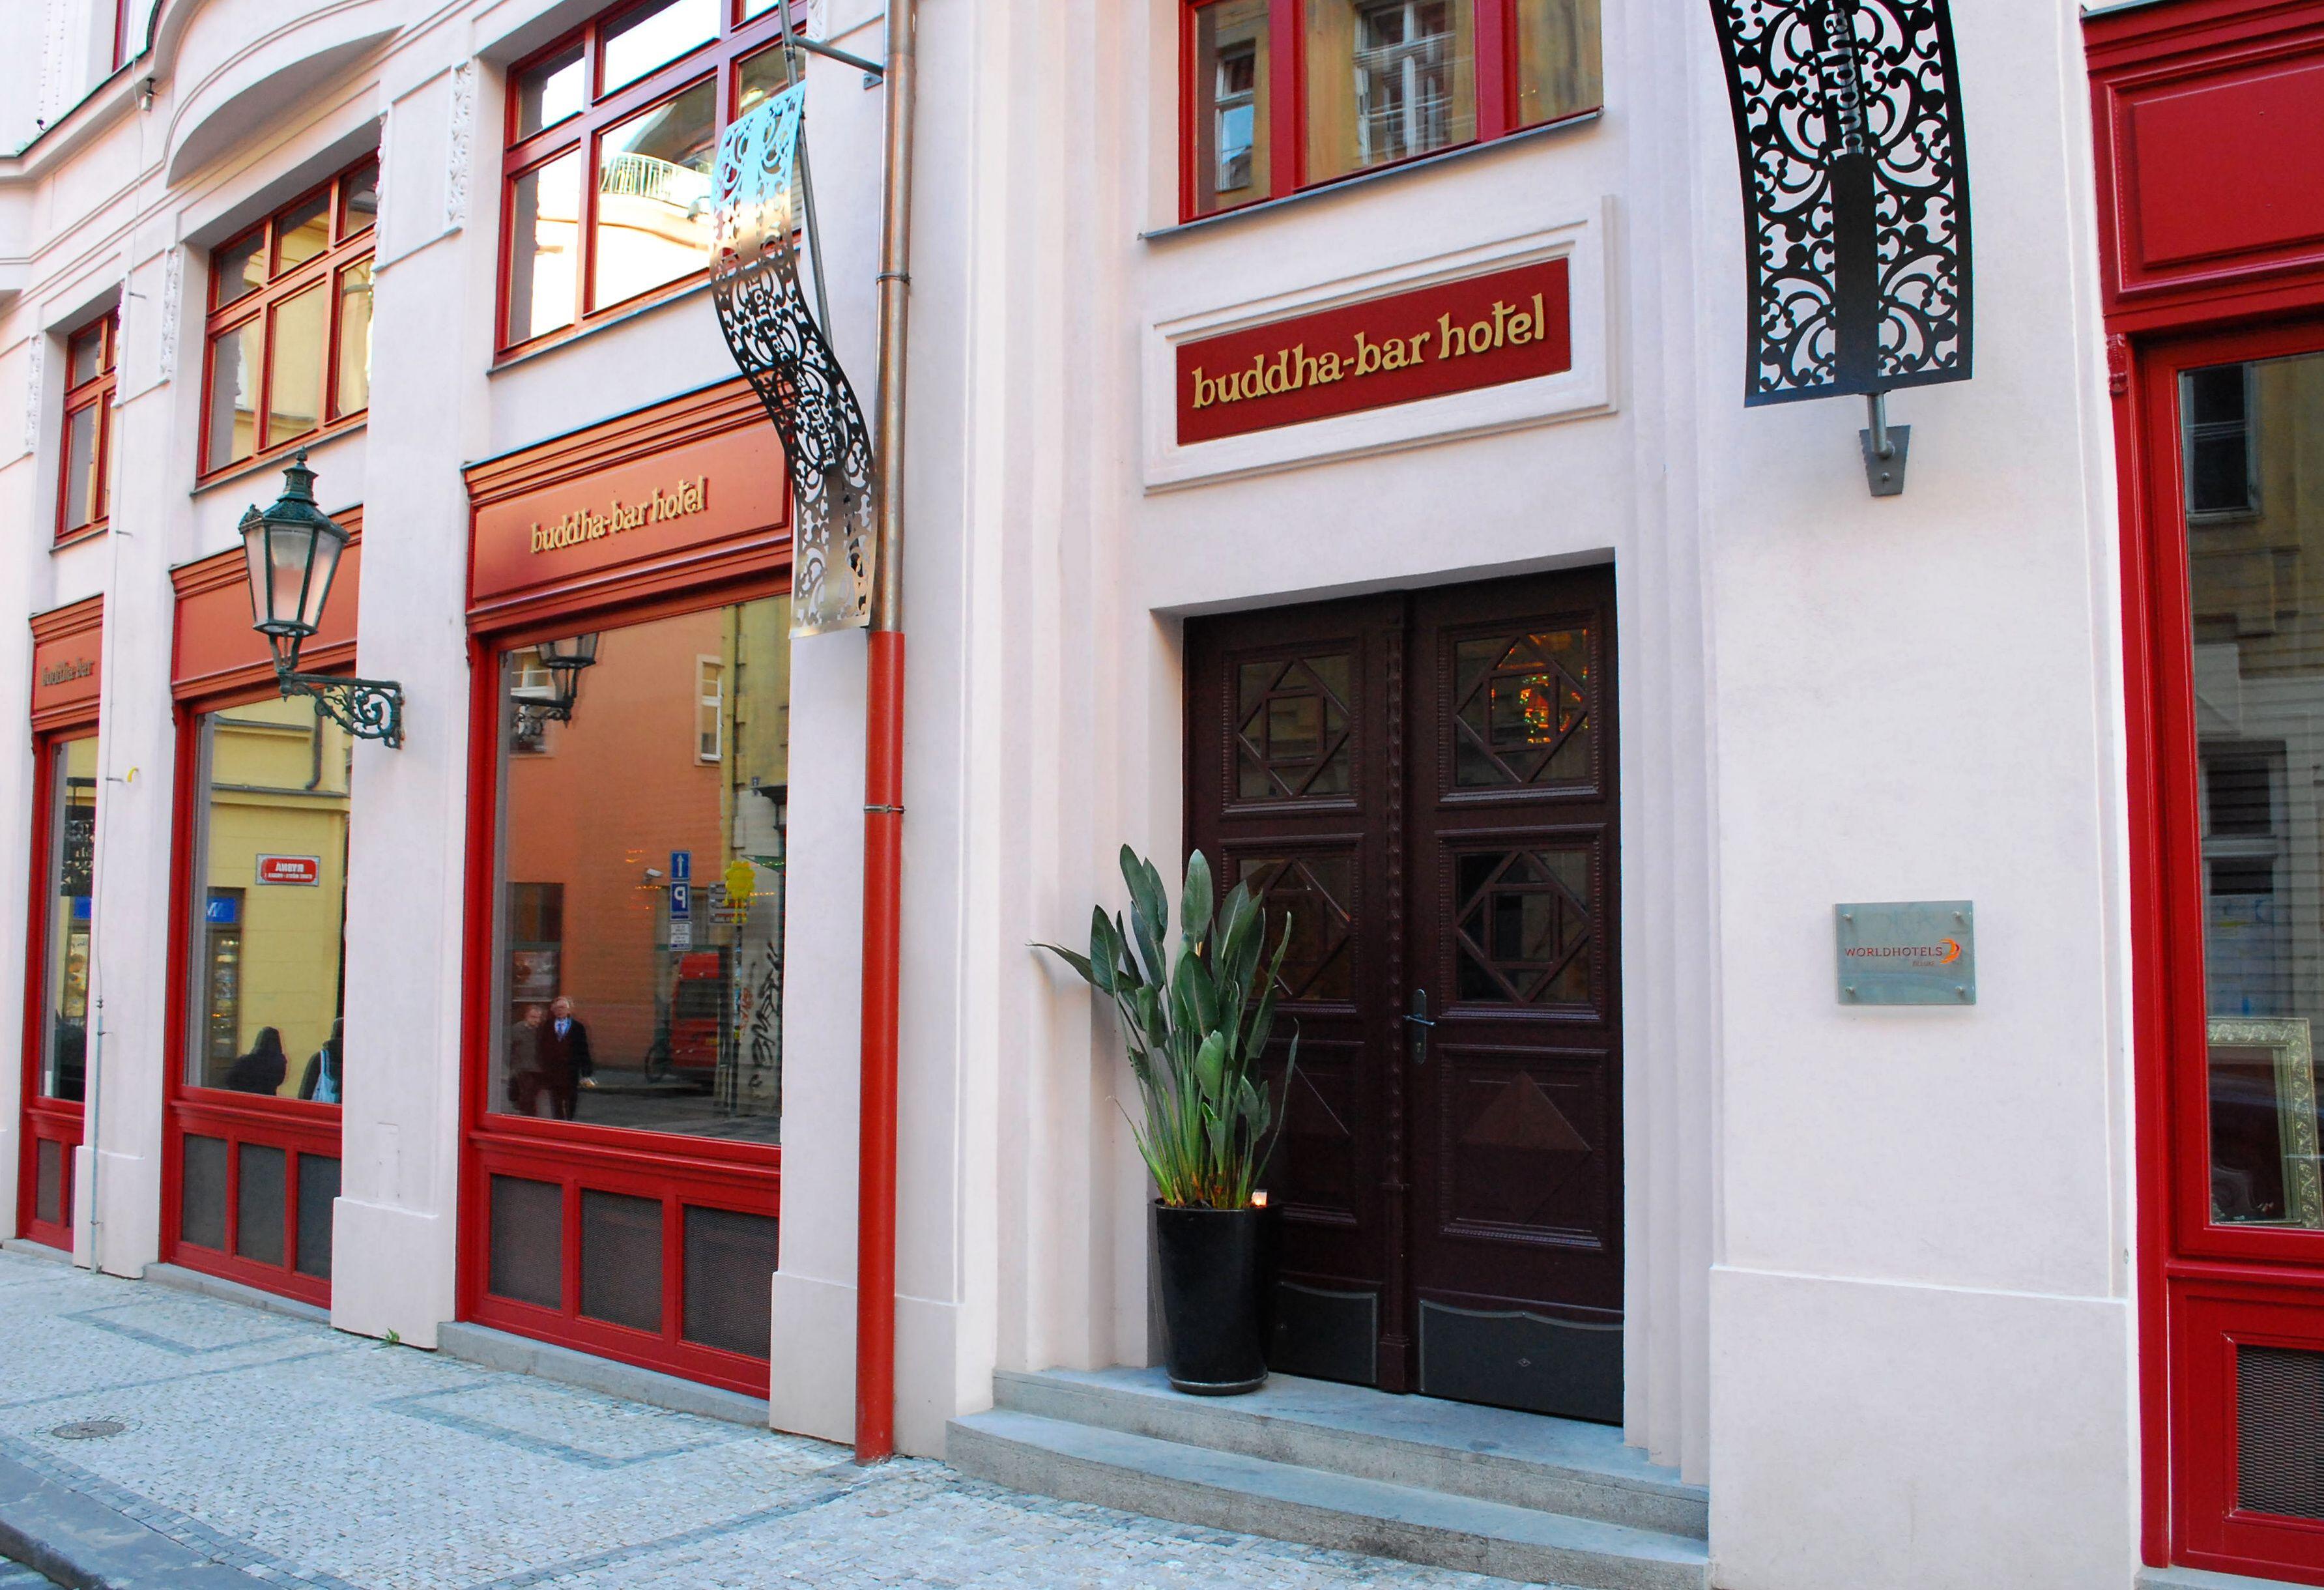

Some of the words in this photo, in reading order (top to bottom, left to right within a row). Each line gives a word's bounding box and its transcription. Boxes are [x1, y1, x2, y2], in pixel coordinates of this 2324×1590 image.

[1192, 330, 1430, 409] buddha-bar
[1437, 293, 1545, 359] hotel
[530, 500, 649, 553] buddha-bar
[650, 475, 706, 522] hotel
[1844, 946, 1944, 957] WORLDHOTELS
